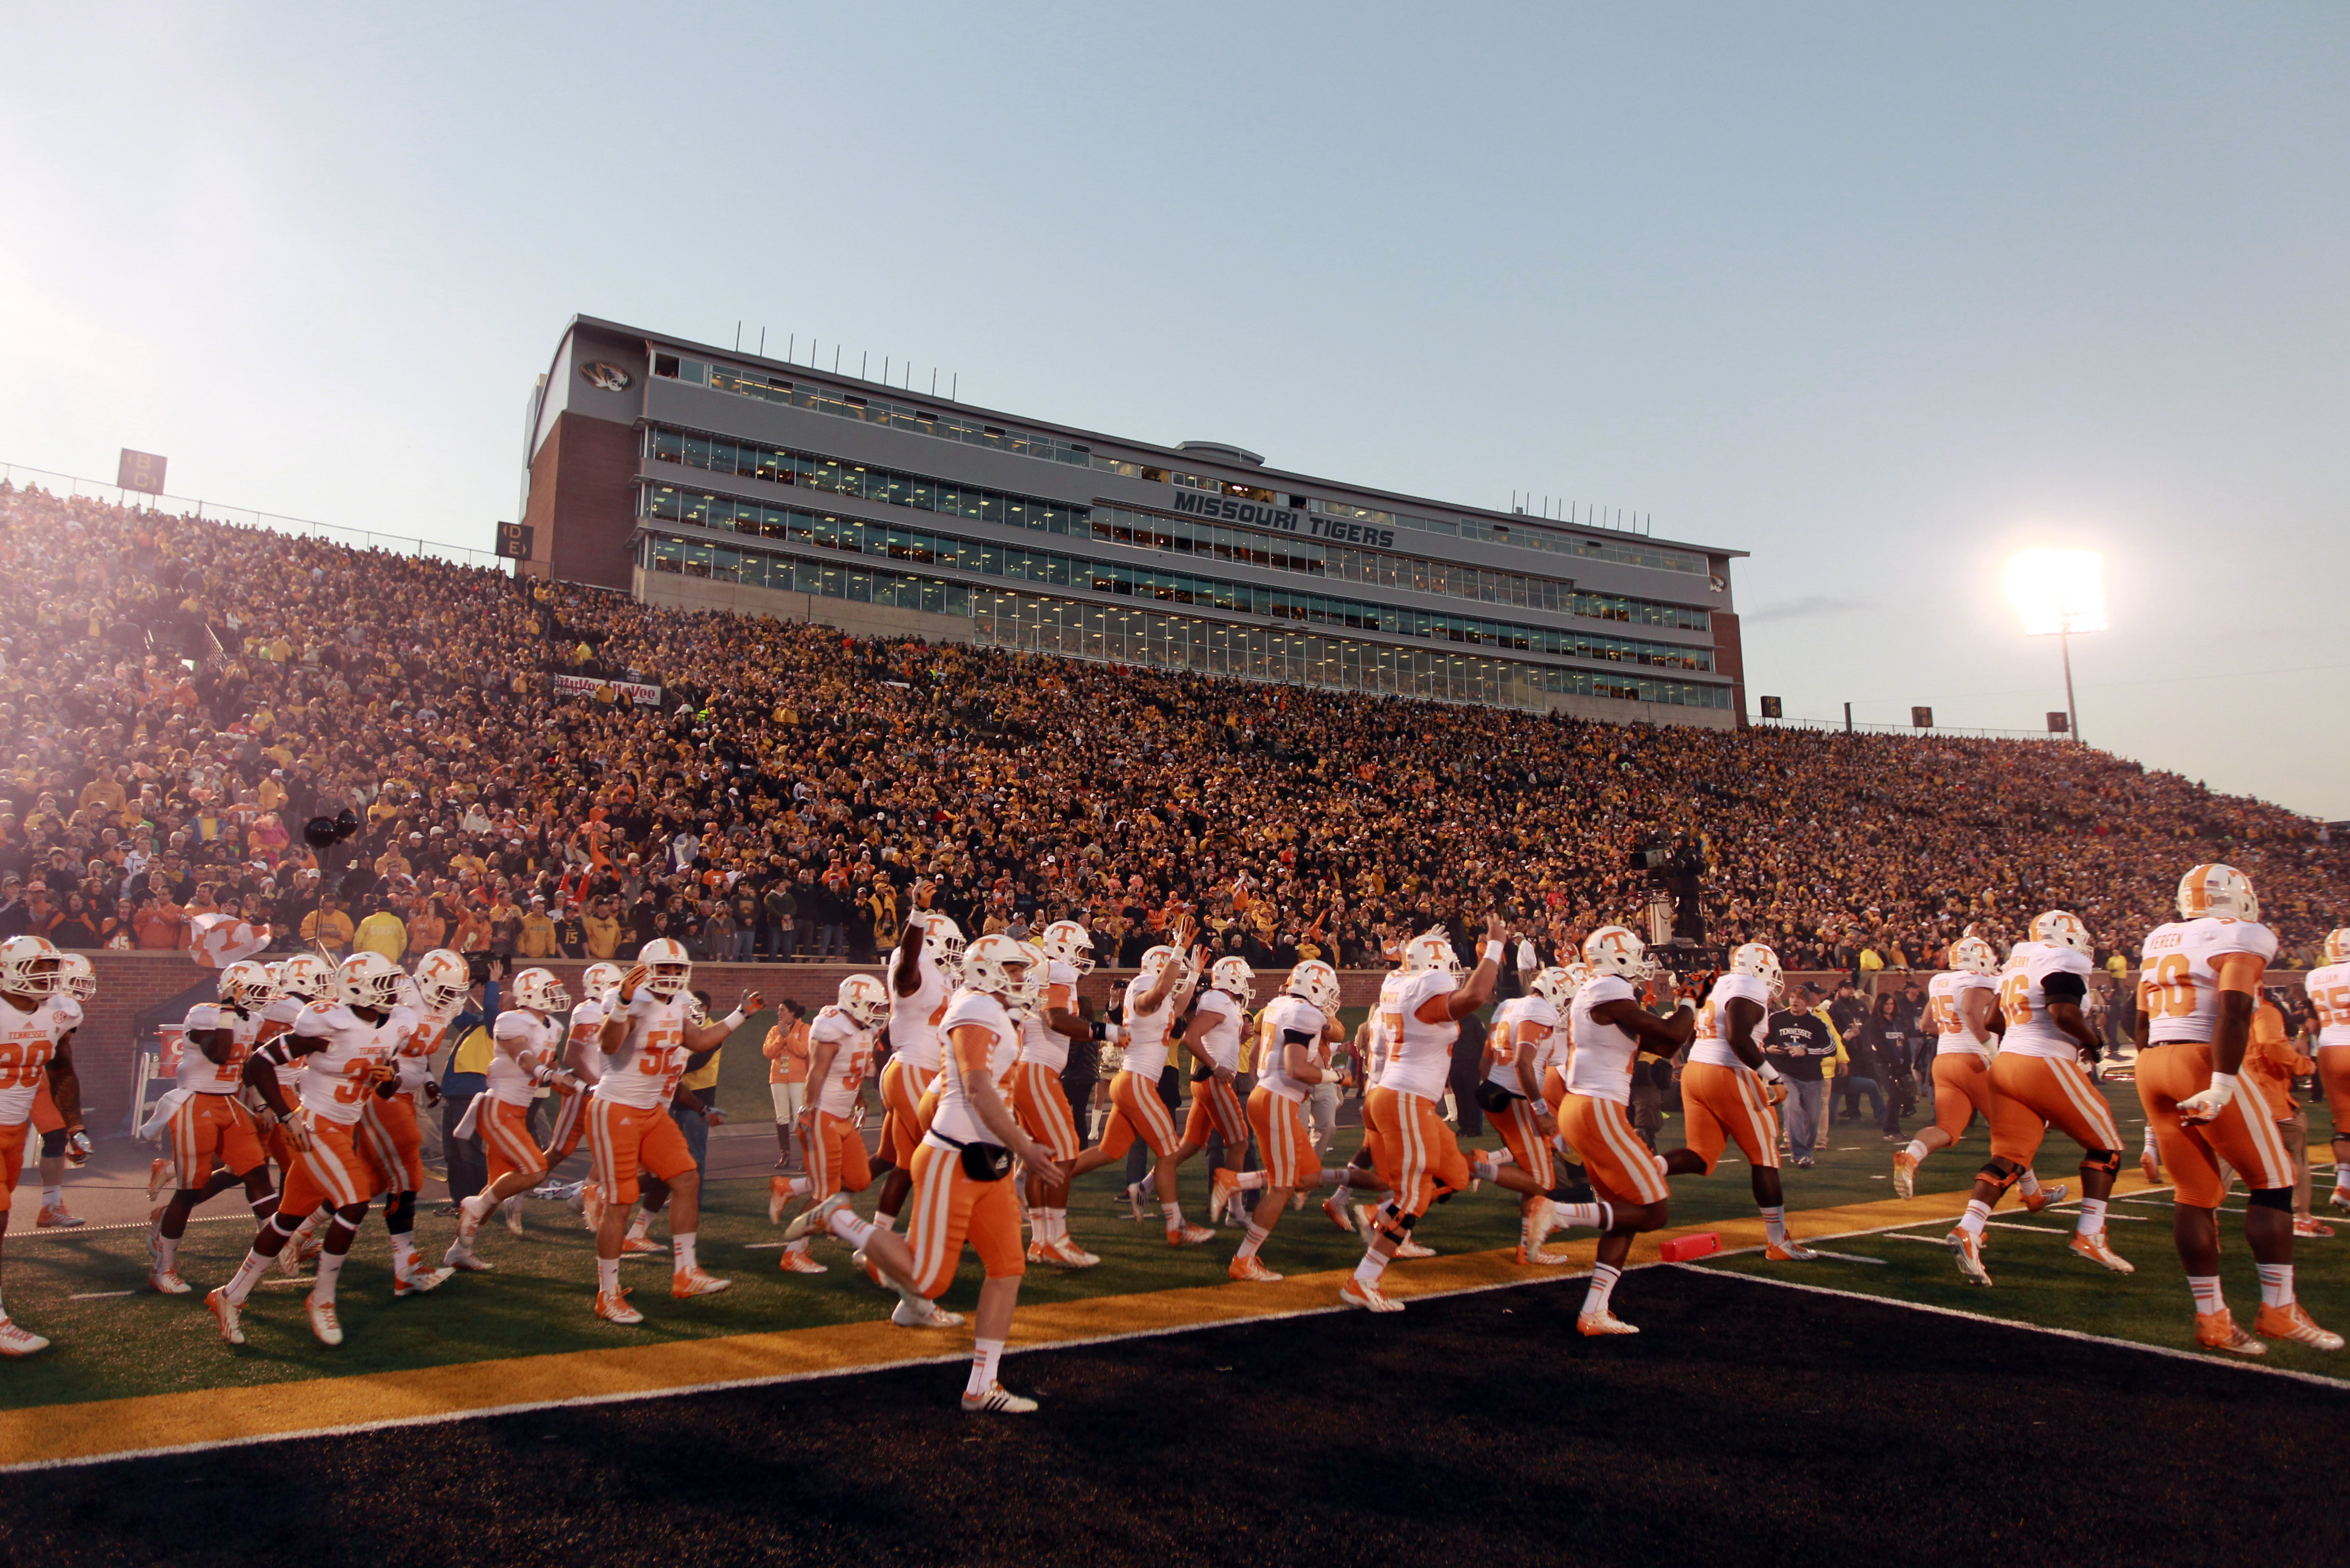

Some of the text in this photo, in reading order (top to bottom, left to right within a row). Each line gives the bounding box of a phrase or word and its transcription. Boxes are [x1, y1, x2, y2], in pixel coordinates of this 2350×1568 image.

[136, 453, 150, 469] B
[135, 473, 149, 488] C
[1174, 491, 1395, 548] MISSOURI TIGERS
[509, 525, 521, 538] D
[509, 541, 520, 555] E
[2206, 894, 2215, 907] 0
[2056, 915, 2078, 933] T
[565, 931, 578, 944] 15
[1055, 925, 1077, 943] T
[1602, 931, 1628, 953] T
[2149, 932, 2184, 950] VEREEN
[974, 939, 999, 962] T
[1423, 940, 1445, 960] T
[1754, 947, 1774, 965] T
[1974, 943, 1989, 958] T
[290, 959, 312, 977] T
[341, 959, 367, 983] T
[427, 956, 452, 977] T
[1225, 960, 1242, 975] T
[1310, 964, 1331, 986] T
[519, 972, 537, 991] T
[589, 969, 606, 984] T
[1555, 970, 1576, 989] T
[850, 981, 870, 999] T
[2141, 953, 2197, 1020] 50
[2311, 985, 2350, 1028] 65
[1779, 1027, 1813, 1039] TENNESSEE
[639, 1030, 683, 1076] 52
